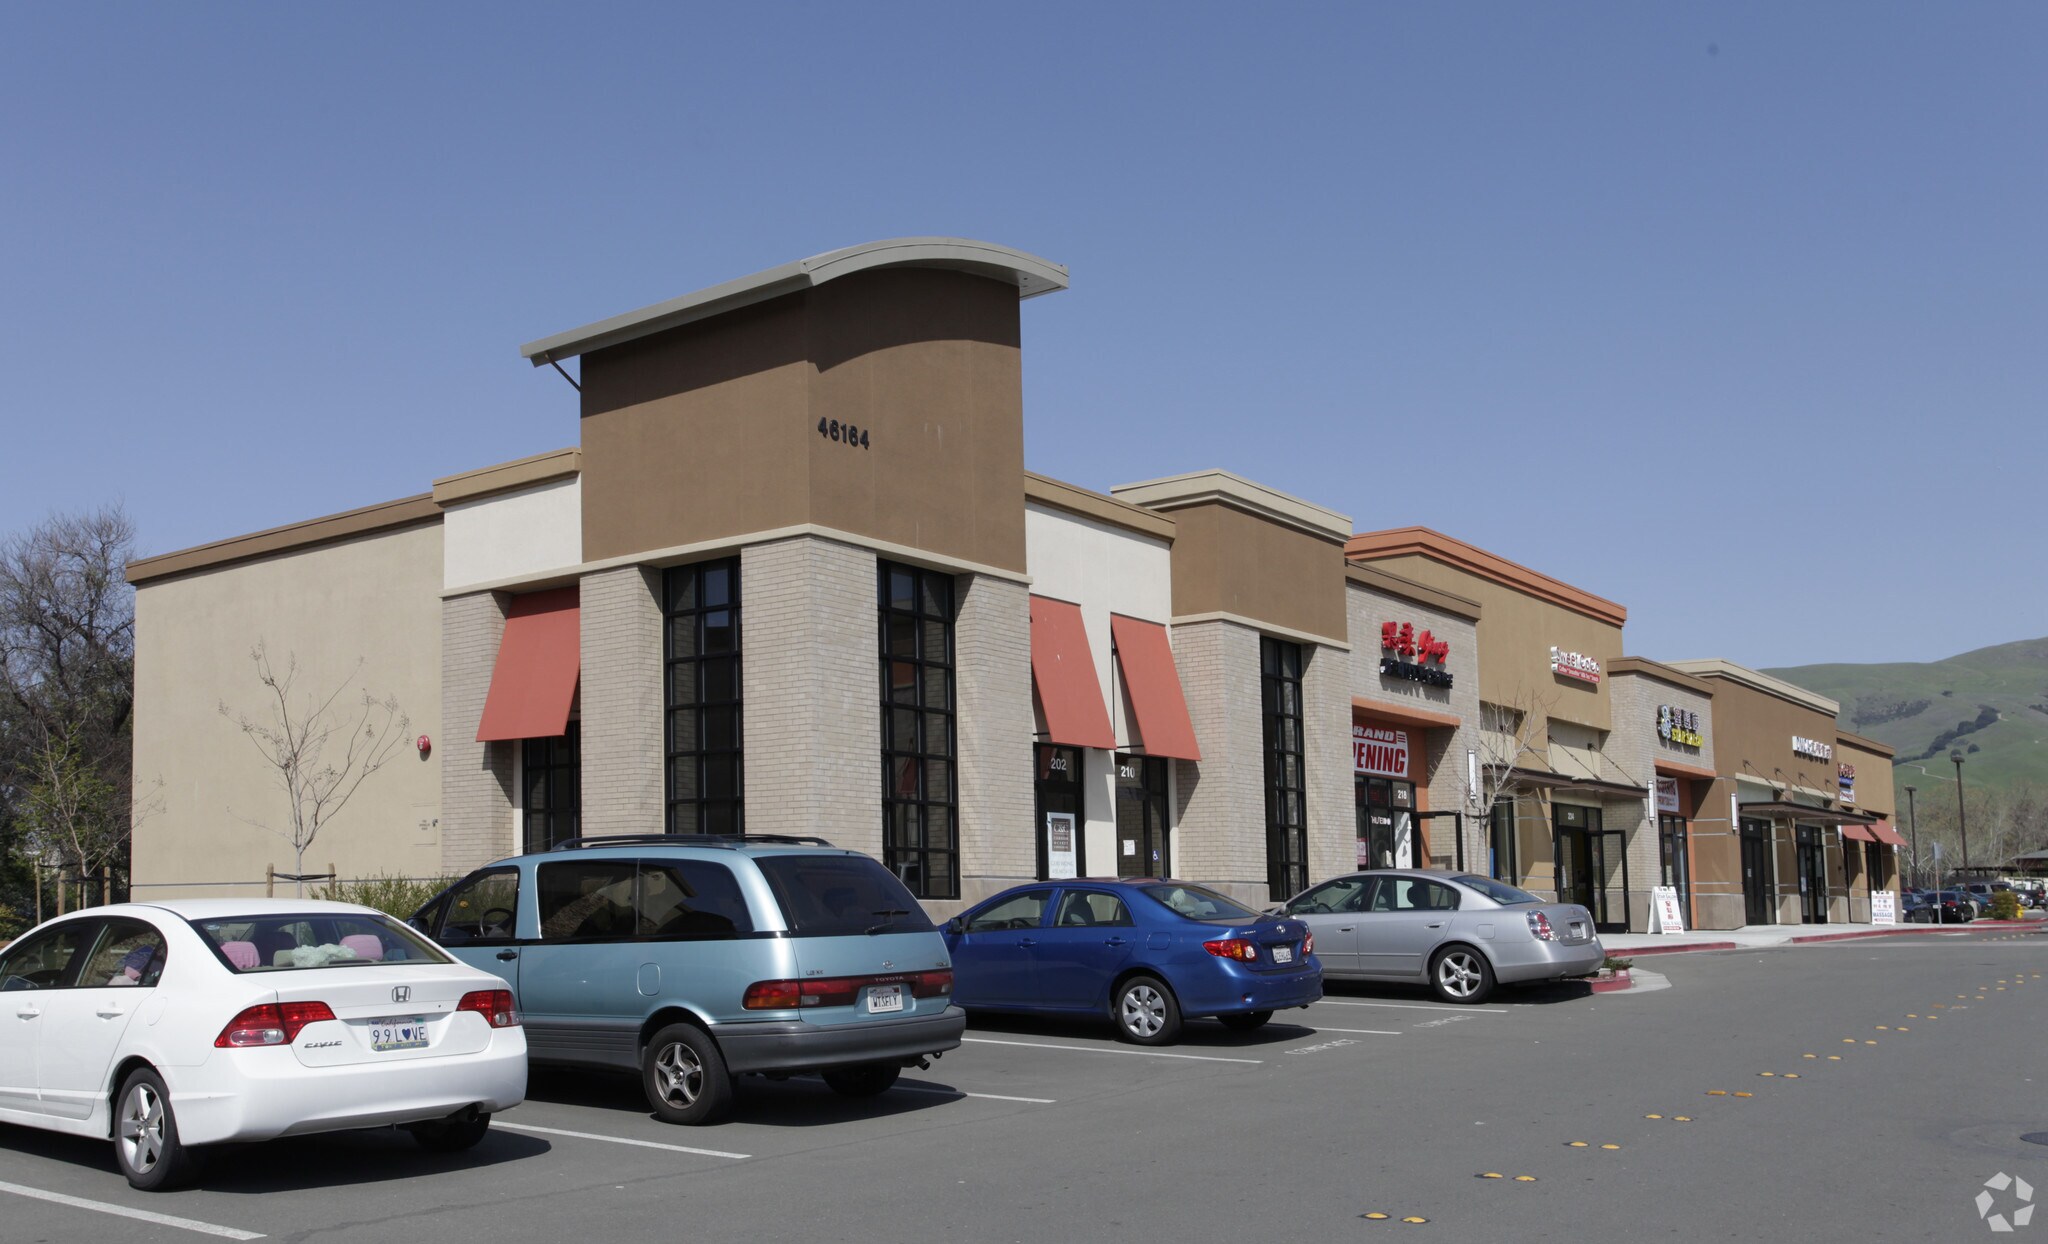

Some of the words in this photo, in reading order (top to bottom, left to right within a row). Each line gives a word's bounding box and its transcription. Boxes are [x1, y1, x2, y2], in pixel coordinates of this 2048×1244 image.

[818, 417, 870, 451] 46164
[1051, 757, 1067, 771] 202
[1120, 765, 1136, 779] 210
[874, 975, 904, 983] TOYOTA
